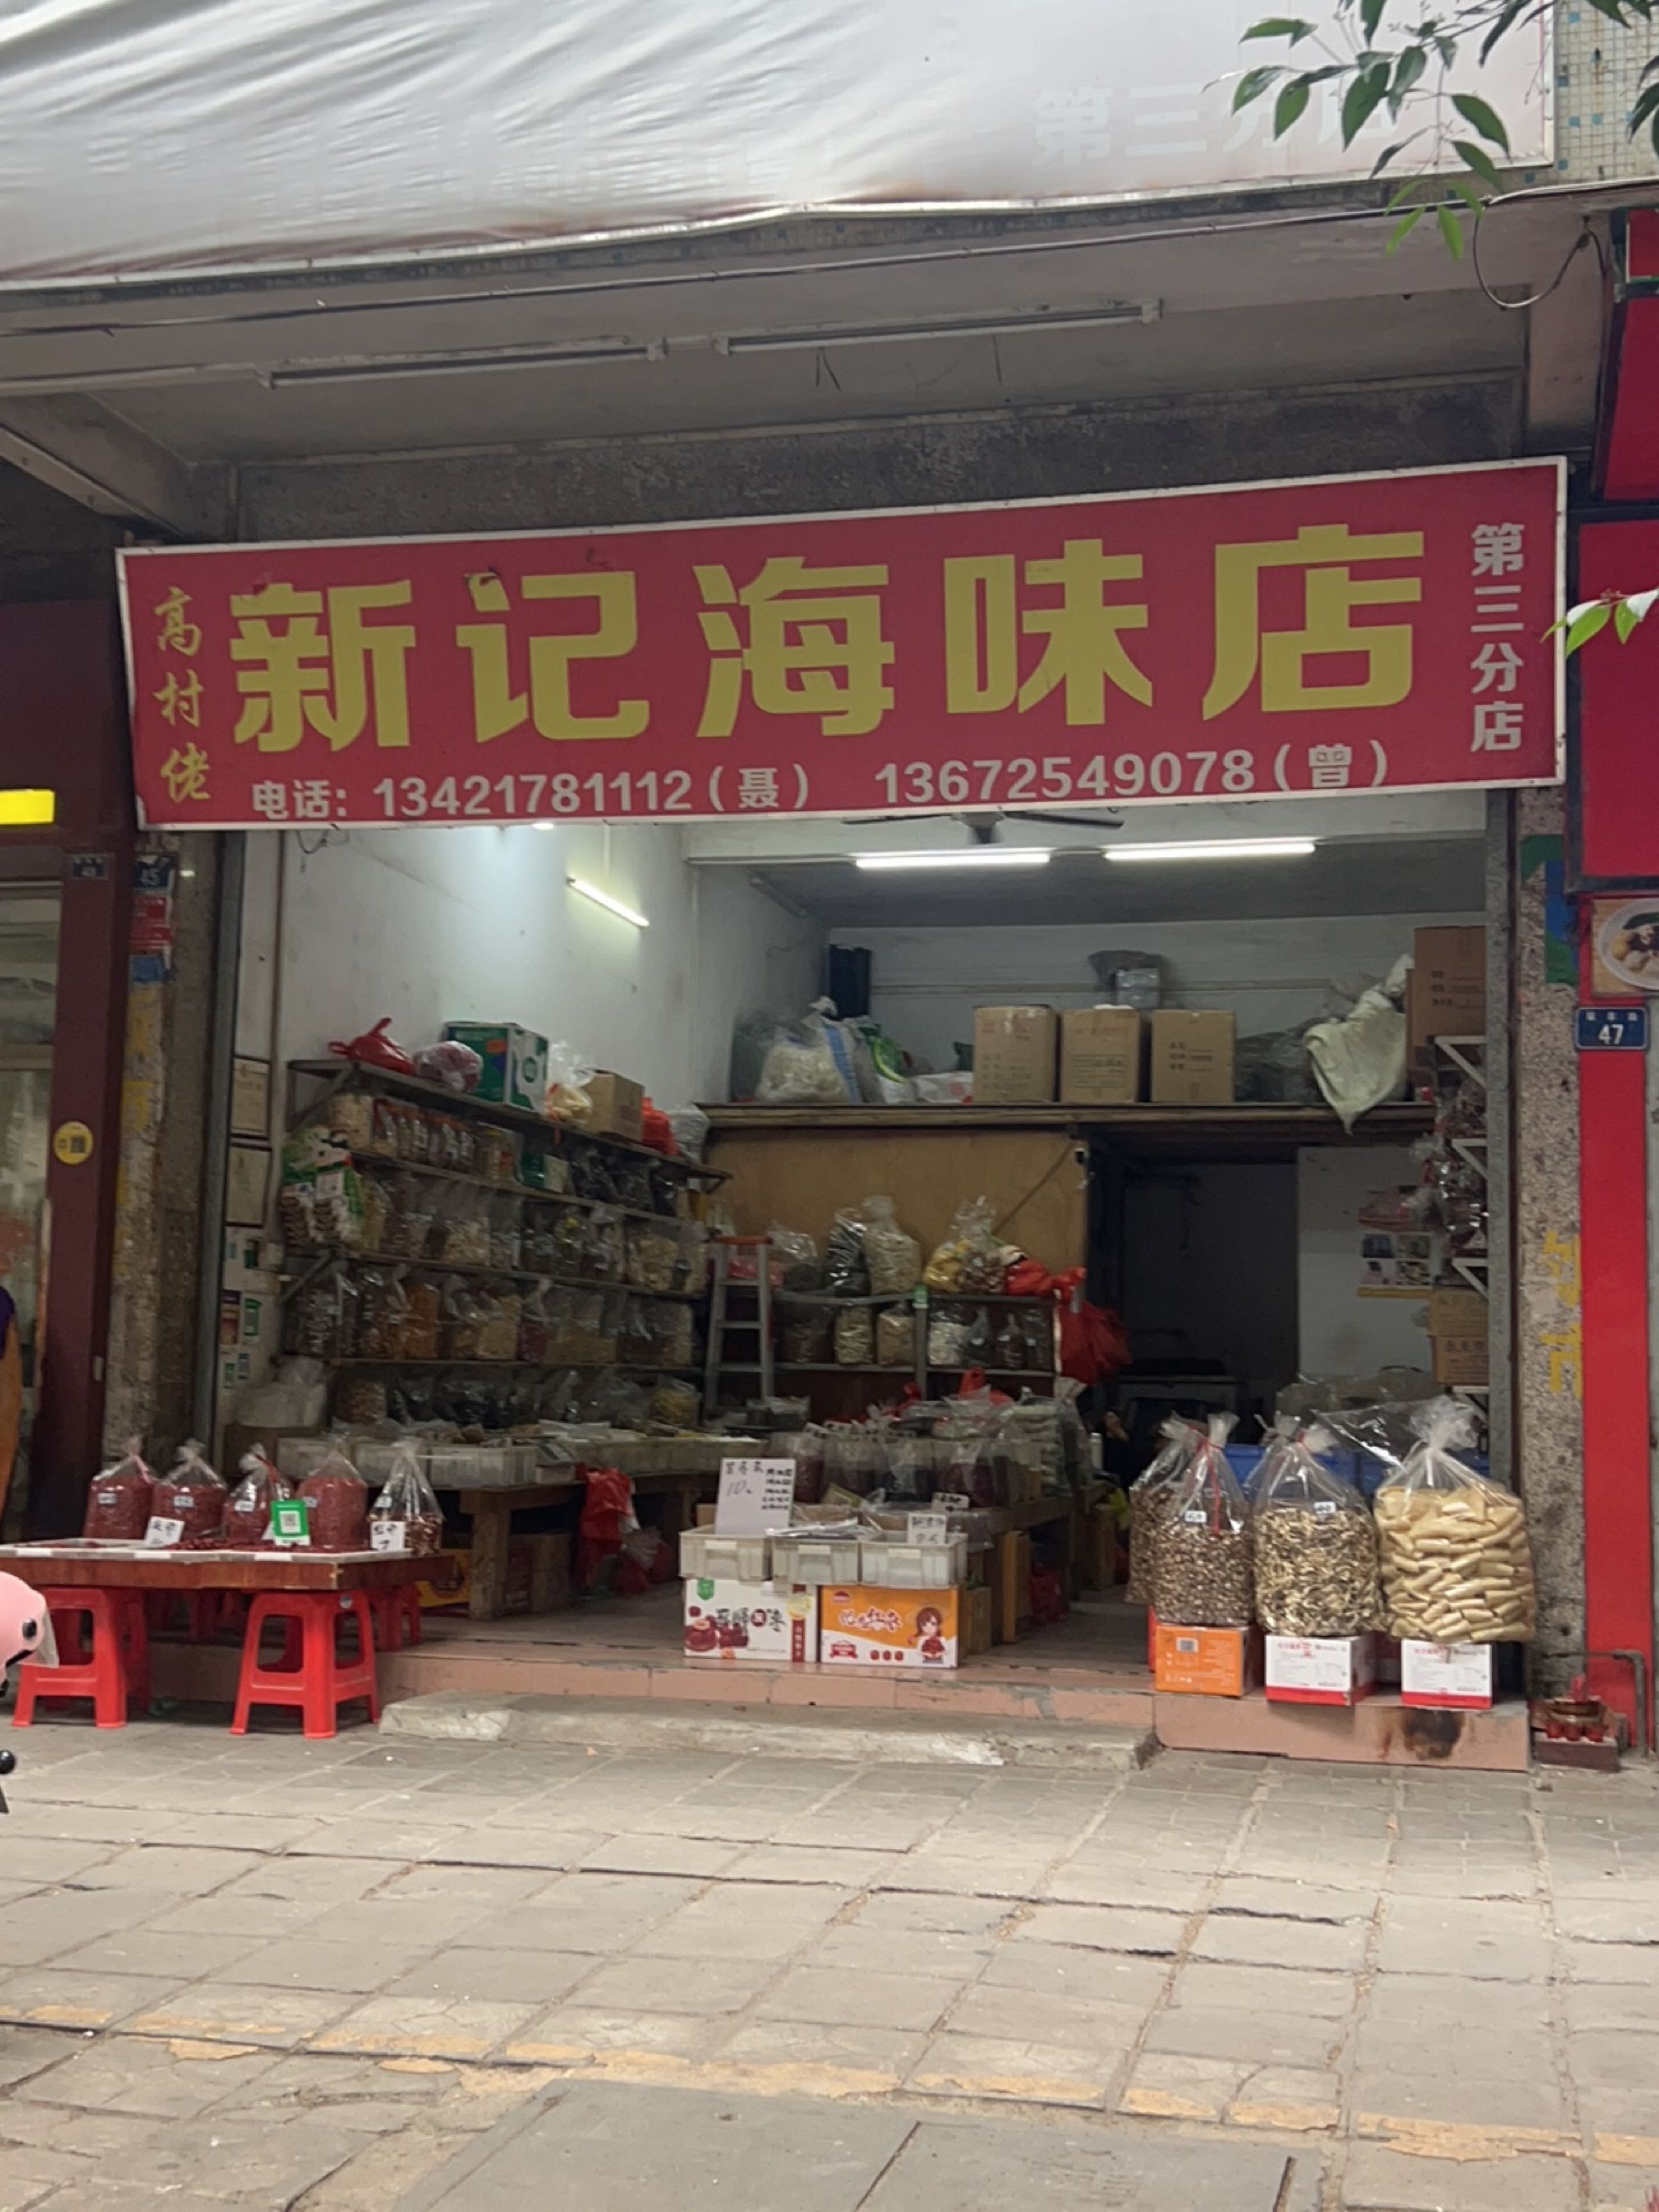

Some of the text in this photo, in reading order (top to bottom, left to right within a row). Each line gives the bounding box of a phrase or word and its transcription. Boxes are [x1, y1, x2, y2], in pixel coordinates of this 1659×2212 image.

[154, 586, 212, 803] 高村佬
[230, 524, 1423, 752] 新记海味店
[1470, 523, 1525, 752] 第三分店
[1598, 1023, 1625, 1045] 47
